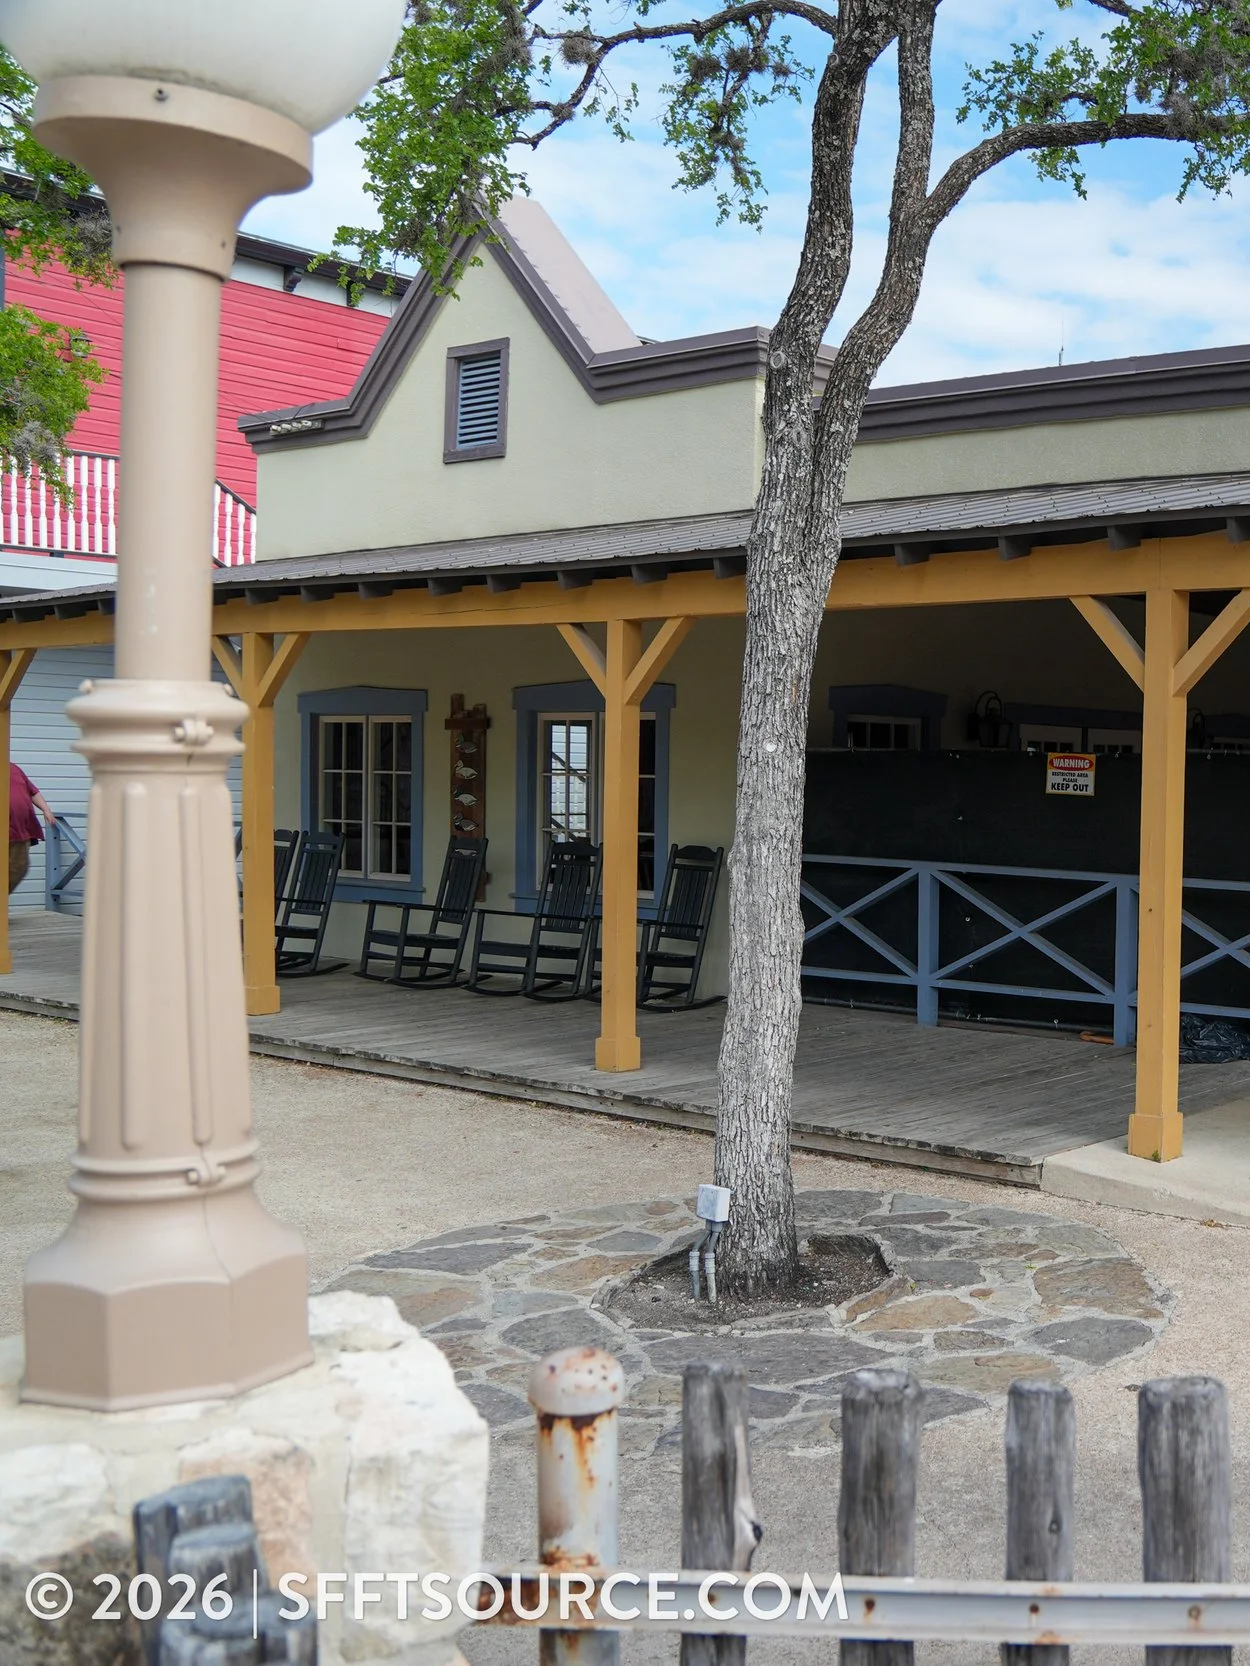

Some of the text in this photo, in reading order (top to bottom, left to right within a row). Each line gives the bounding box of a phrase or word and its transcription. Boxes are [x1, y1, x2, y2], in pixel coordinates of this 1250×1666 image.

[1053, 758, 1090, 768] WARNING
[1051, 783, 1088, 792] KEEP OUT
